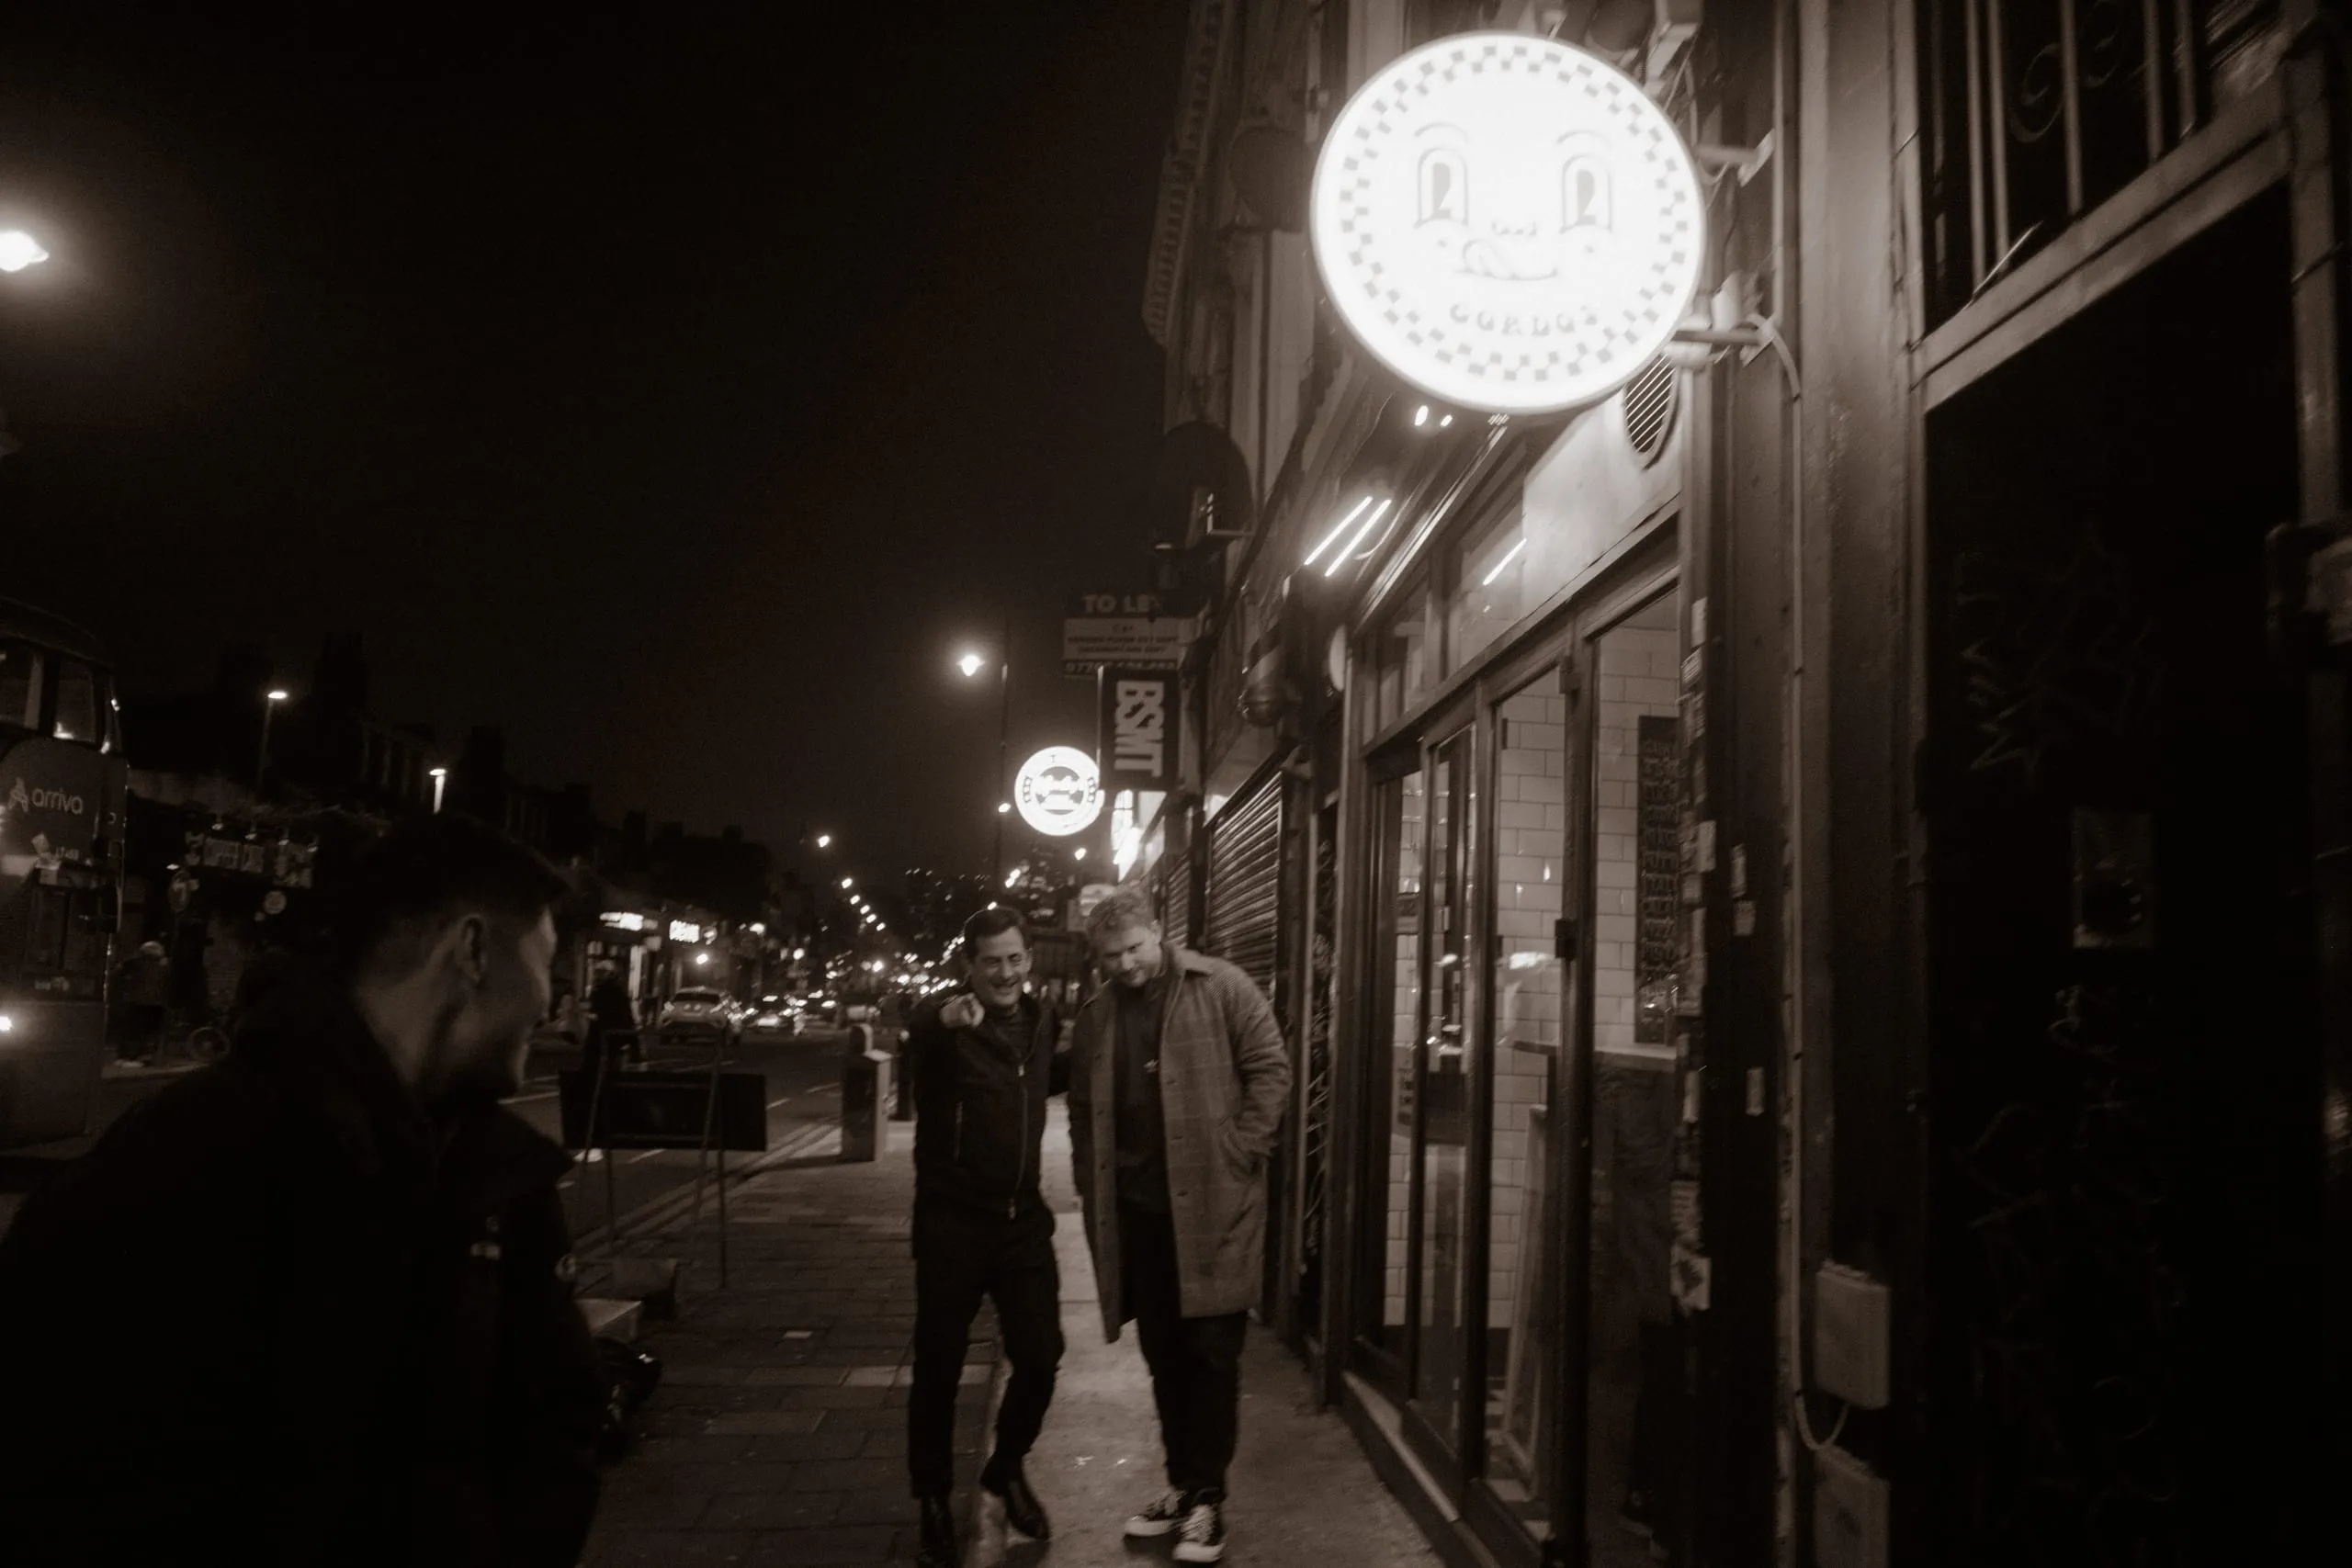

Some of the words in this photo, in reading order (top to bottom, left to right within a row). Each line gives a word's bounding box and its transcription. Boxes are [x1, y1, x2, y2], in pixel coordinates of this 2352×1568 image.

[1081, 593, 1117, 614] TO
[1114, 681, 1164, 777] BSMT
[32, 787, 84, 816] arriva
